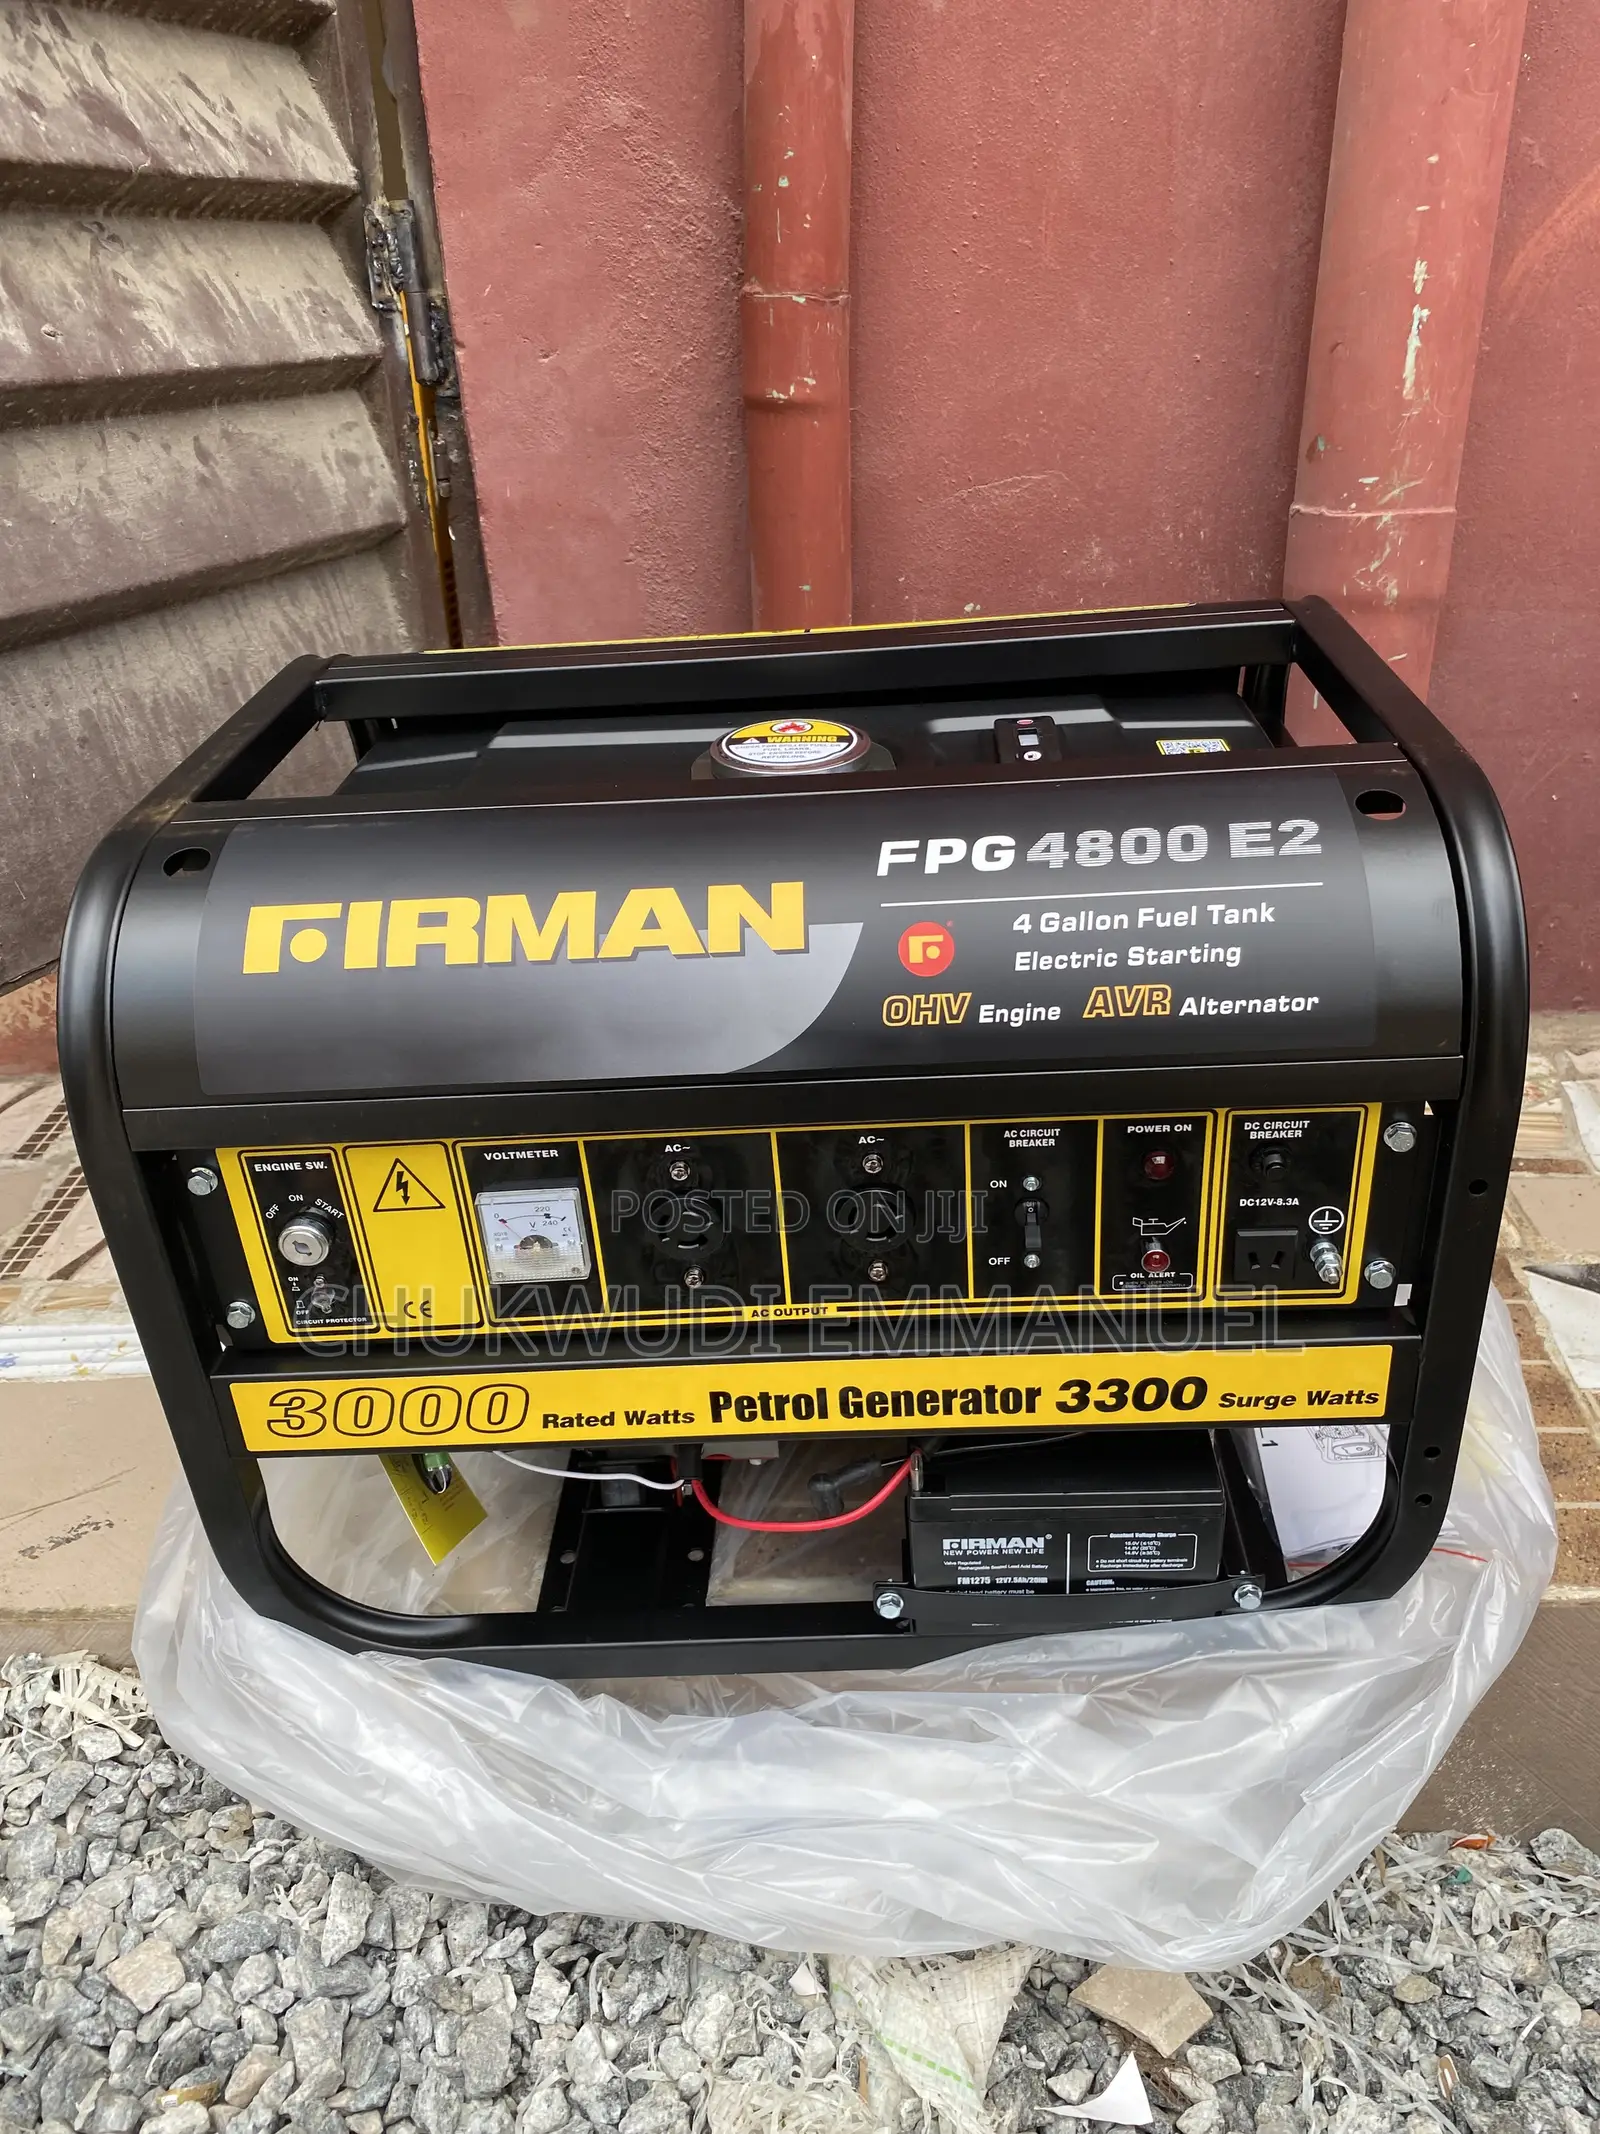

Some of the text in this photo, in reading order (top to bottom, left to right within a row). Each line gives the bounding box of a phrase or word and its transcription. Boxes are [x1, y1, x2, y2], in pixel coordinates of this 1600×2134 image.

[767, 735, 838, 743] WARNING
[876, 819, 1323, 877] FPG 4800 E2
[1012, 902, 1276, 934] 4 Gallon Fuel Tank
[242, 881, 804, 975] FIRMAN
[1014, 942, 1242, 972] Electric Starting
[882, 983, 1320, 1028] OHV Engine AVR Alternator
[1127, 1124, 1192, 1134] POWER ON
[1244, 1120, 1310, 1131] DC CIRCUIT
[1004, 1128, 1061, 1138] AC CIRCUIT
[1250, 1130, 1302, 1140] BREAKER
[1008, 1138, 1056, 1148] BREAKER
[484, 1148, 559, 1162] VOLTMETER
[254, 1160, 329, 1172] ENGINE SW.
[990, 1180, 1008, 1189] ON
[288, 1194, 304, 1202] ON
[1239, 1198, 1300, 1207] DC12V-8.3A
[265, 1203, 280, 1220] OFF
[314, 1198, 345, 1219] START
[988, 1256, 1011, 1266] OFF
[750, 1306, 829, 1318] AC OUTPUT
[267, 1377, 1380, 1438] 3000 Rated Watts Petrol Generator 3300 Surge Watts
[942, 1536, 1045, 1550] FIRMAN
[957, 1576, 991, 1585] FM1275
